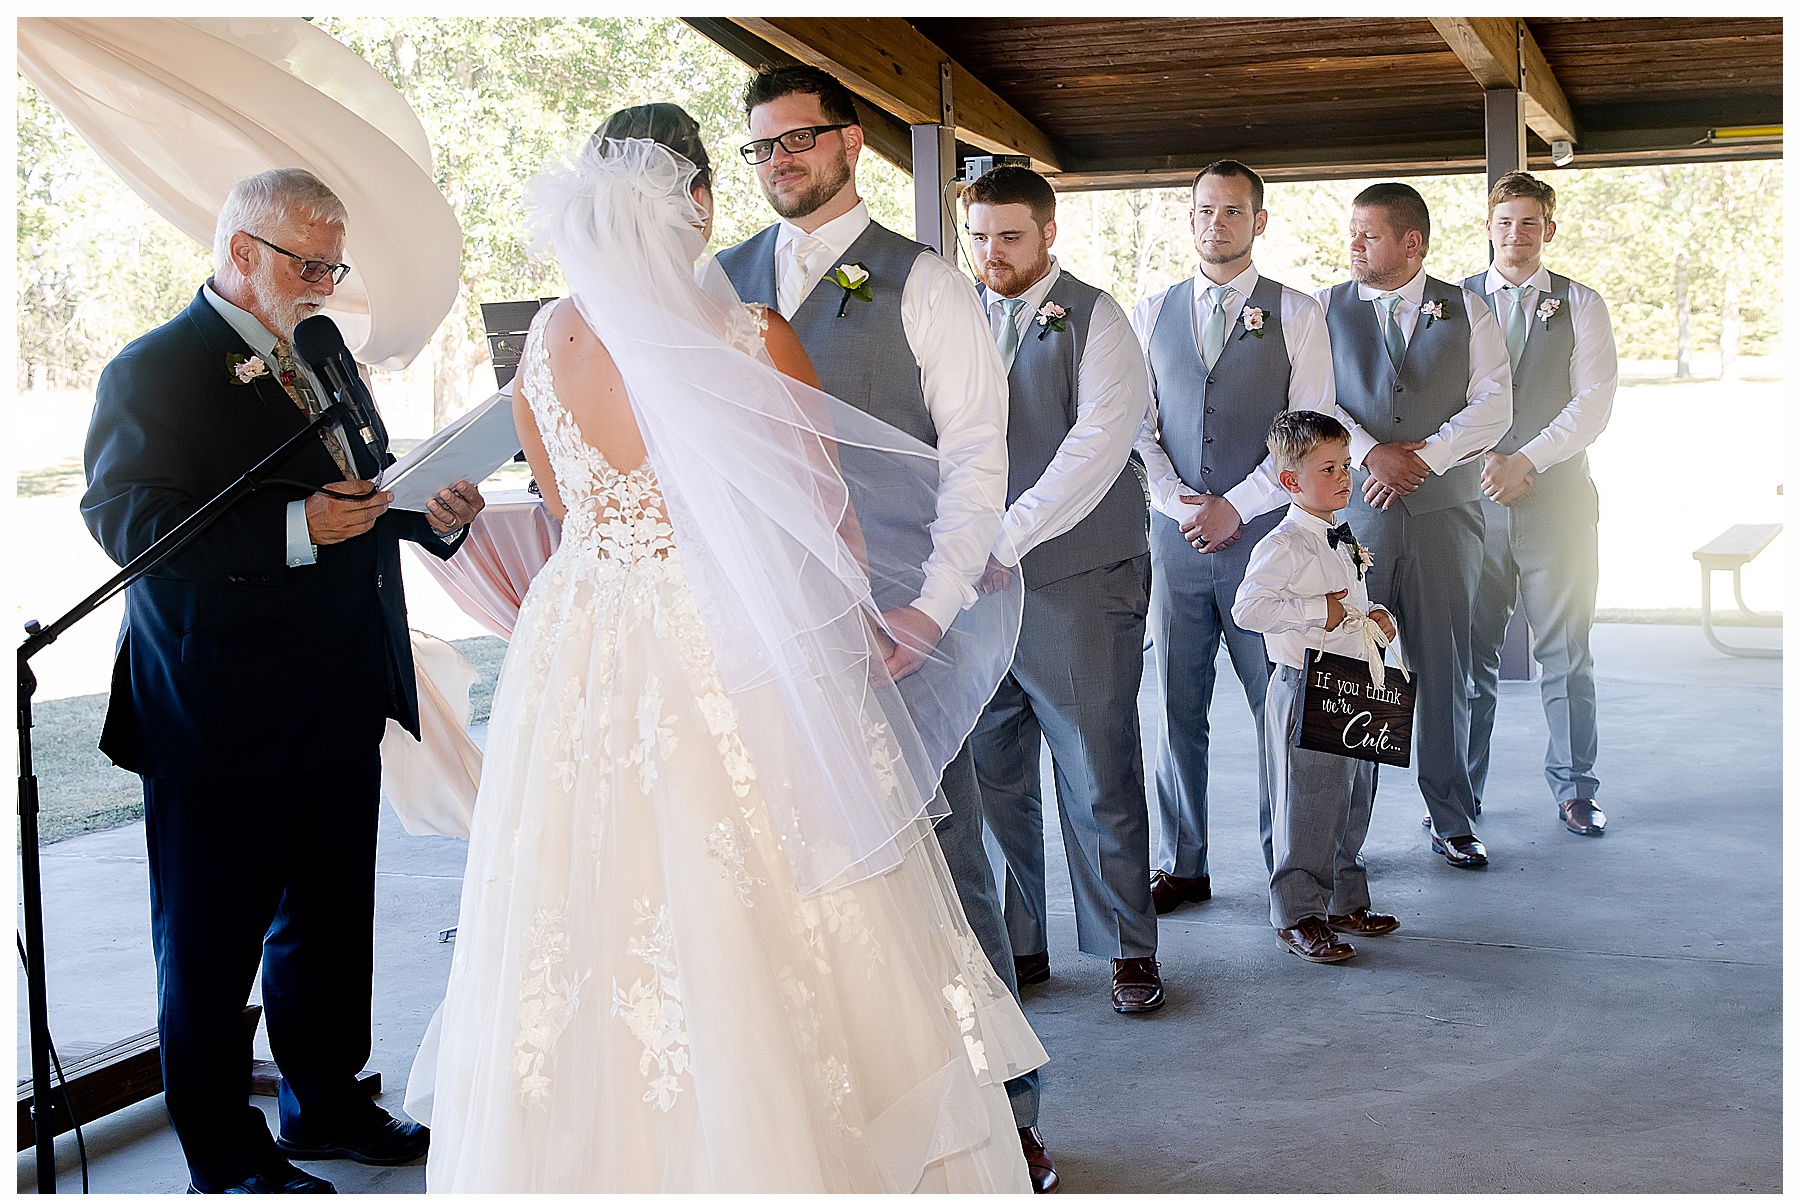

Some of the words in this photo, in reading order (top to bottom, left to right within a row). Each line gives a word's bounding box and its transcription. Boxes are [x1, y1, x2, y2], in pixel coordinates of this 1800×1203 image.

[1315, 671, 1332, 690] If
[1337, 679, 1359, 696] you
[1366, 682, 1402, 705] think
[1322, 698, 1354, 715] we're
